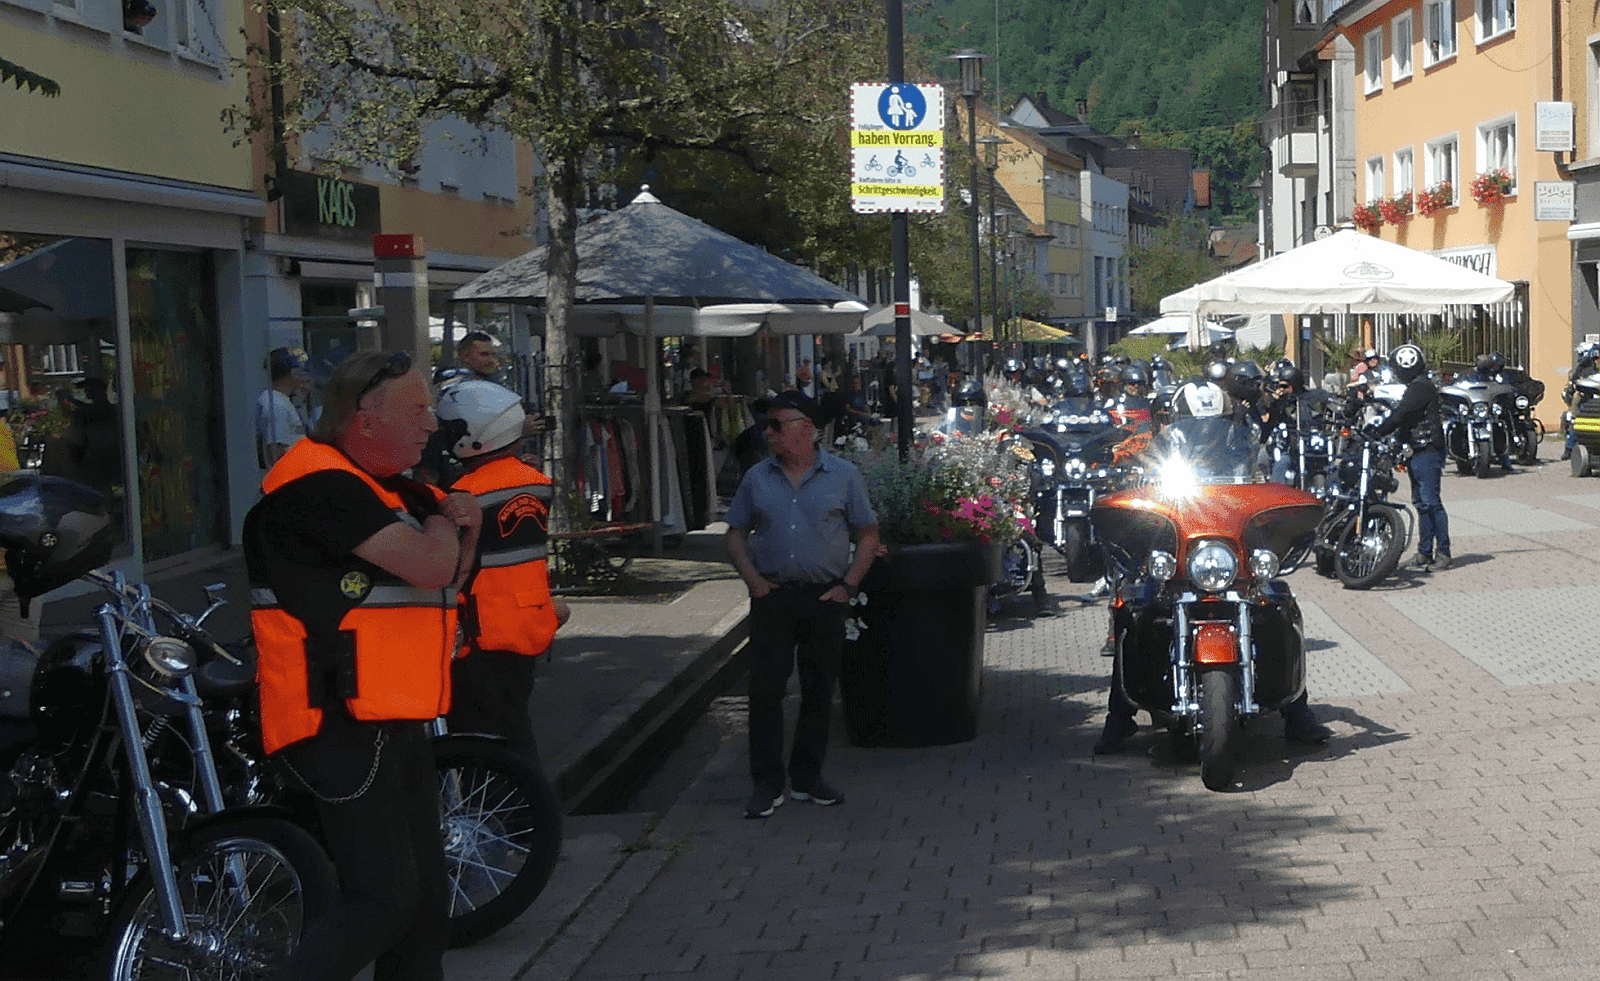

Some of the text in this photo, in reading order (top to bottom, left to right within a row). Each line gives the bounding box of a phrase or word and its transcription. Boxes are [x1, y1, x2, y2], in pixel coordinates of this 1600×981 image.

[858, 132, 937, 147] haben Vorrang.
[858, 185, 939, 197] Schrittgeschwindigkeit.
[318, 178, 356, 227] KAOS
